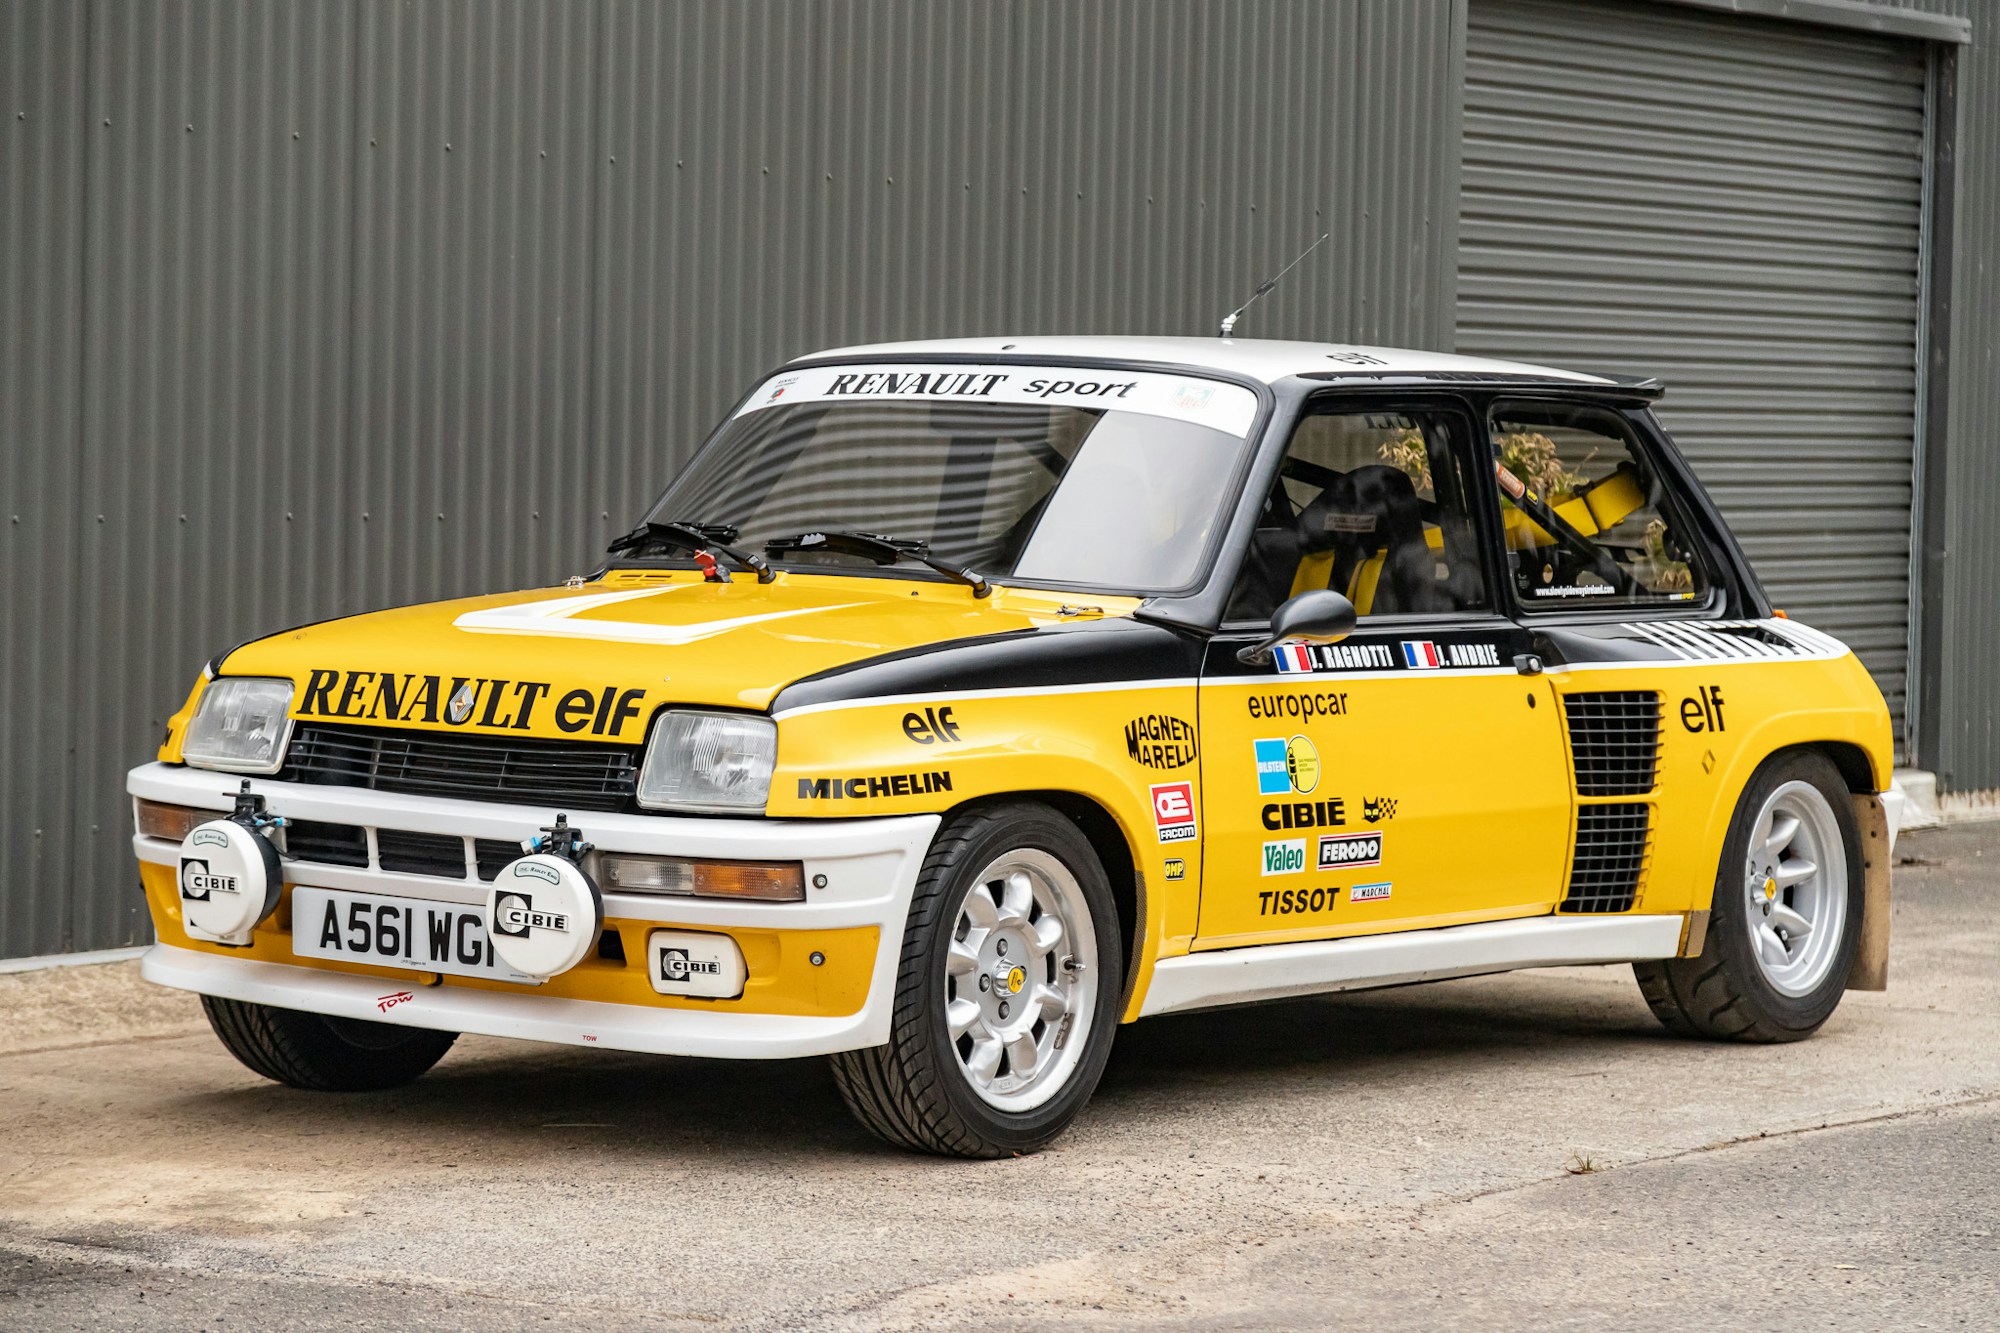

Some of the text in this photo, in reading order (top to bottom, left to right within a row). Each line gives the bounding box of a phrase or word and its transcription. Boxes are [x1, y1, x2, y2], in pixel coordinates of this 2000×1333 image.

[823, 373, 1139, 399] RENAULT sport
[1308, 644, 1394, 669] J. RAGNOTTI
[1436, 644, 1500, 667] J. ANDRIE
[296, 669, 646, 736] RENAULT elf
[1248, 692, 1348, 723] europcar
[1680, 685, 1725, 733] elf
[902, 706, 961, 745] elf
[1124, 714, 1195, 744] MAGNETI
[1128, 743, 1197, 769] MARELLI
[798, 771, 953, 800] MICHELIN
[1160, 827, 1194, 840] FACOM
[1165, 863, 1184, 877] OMP
[1264, 840, 1379, 872] Valeo FERODO
[1259, 887, 1340, 916] TISSOT
[320, 899, 413, 958] A561
[377, 994, 414, 1013] TOW
[582, 1034, 598, 1042] TOW
